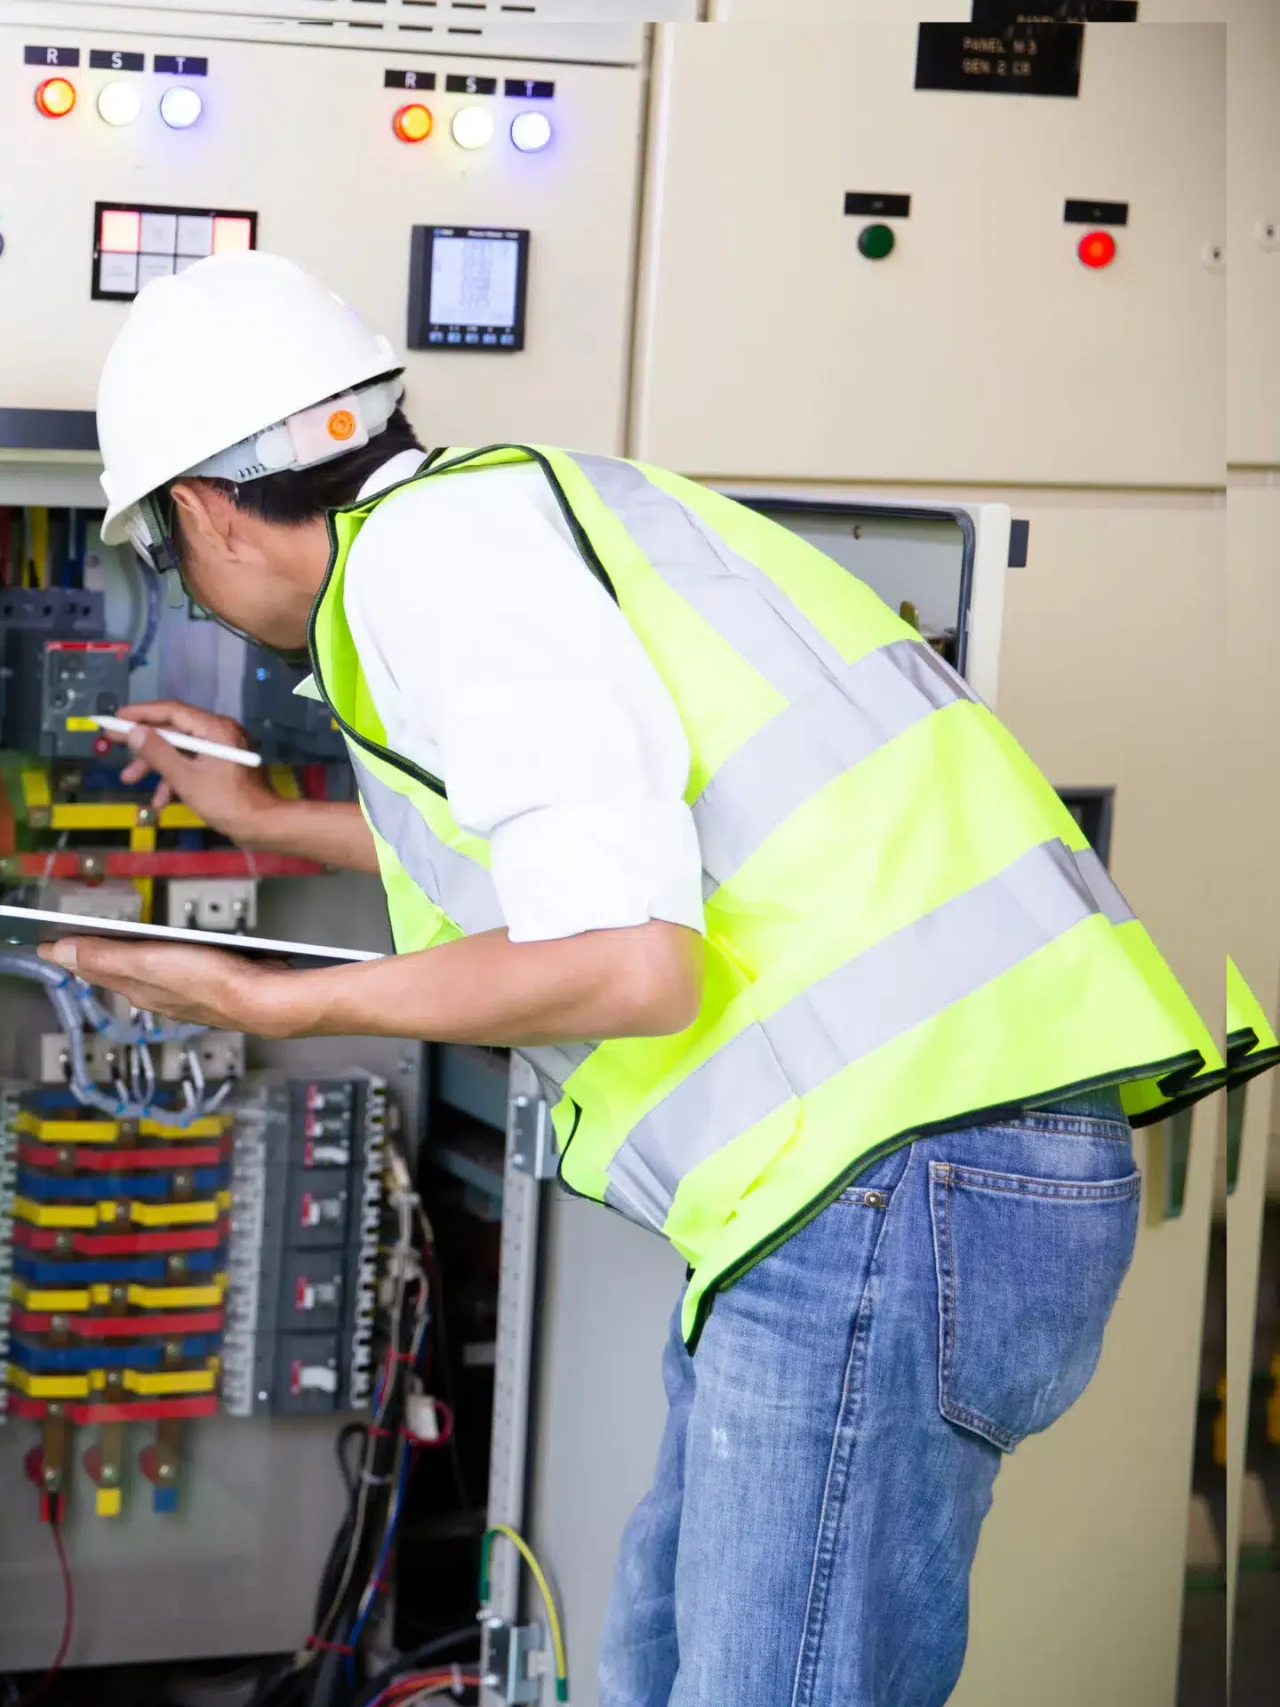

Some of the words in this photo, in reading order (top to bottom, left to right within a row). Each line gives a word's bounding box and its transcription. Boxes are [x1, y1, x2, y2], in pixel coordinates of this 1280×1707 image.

[46, 47, 59, 65] R
[111, 52, 123, 69] S
[175, 56, 186, 73] T
[404, 71, 417, 89] R
[465, 76, 477, 94] S
[524, 80, 535, 97] T
